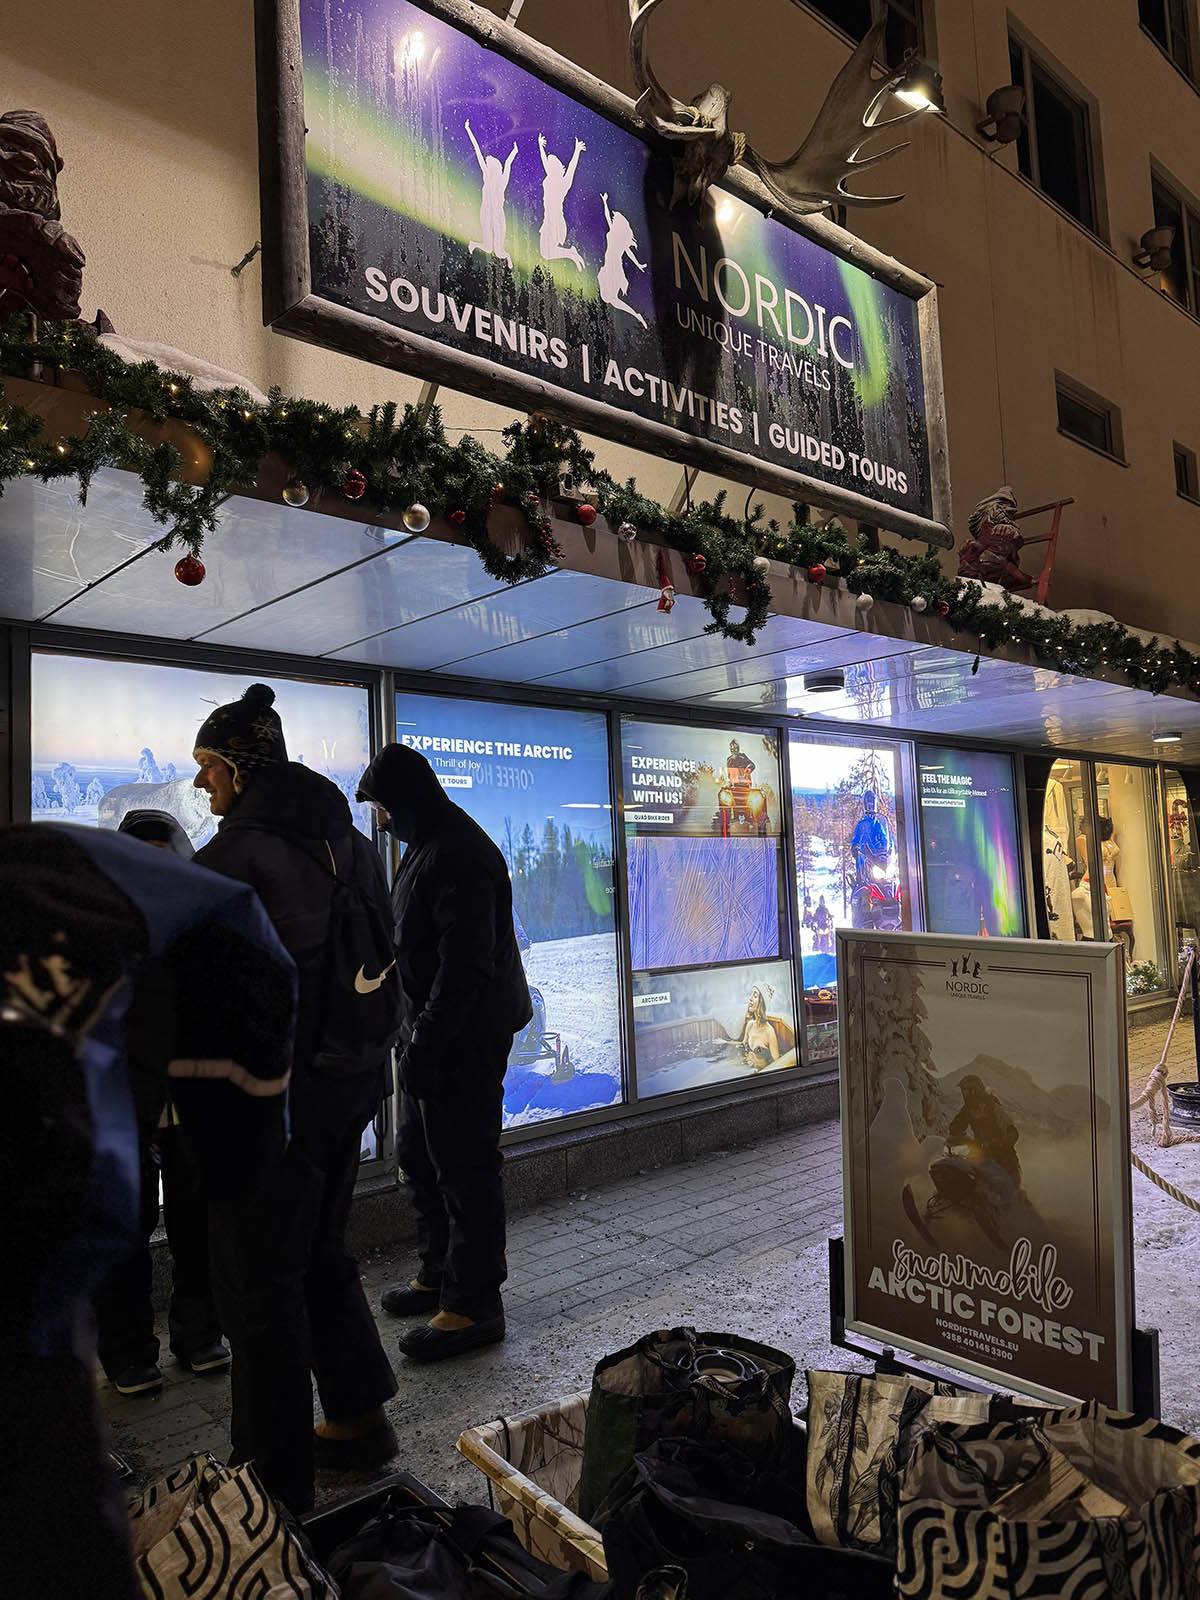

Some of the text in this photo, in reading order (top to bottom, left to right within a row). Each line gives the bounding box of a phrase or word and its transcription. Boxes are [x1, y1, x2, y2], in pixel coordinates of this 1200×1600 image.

[672, 231, 854, 369] NORDIC
[676, 302, 831, 391] UNIQUE TRAVELS
[365, 267, 568, 369] SOUVENIRS
[603, 359, 743, 434] ACTIVITIES
[768, 423, 845, 471] GUIDED
[849, 451, 908, 494] TOURS
[401, 734, 573, 761] EXPERIENCE THE ARCTIC
[434, 757, 456, 768] Thrill
[457, 759, 466, 769] of
[468, 760, 481, 770] Joy
[631, 756, 696, 772] EXPERIENCE
[632, 773, 682, 788] LAPLAND
[922, 773, 973, 786] FEEL THE MAGIC
[633, 790, 683, 805] WITH US!
[945, 980, 989, 995] NORDIC
[868, 1267, 1105, 1362] ARCTIC FOREST
[935, 1318, 1019, 1352] NORDICTRAVELS.EU
[942, 1331, 962, 1343] +358
[991, 1347, 1013, 1360] 3300
